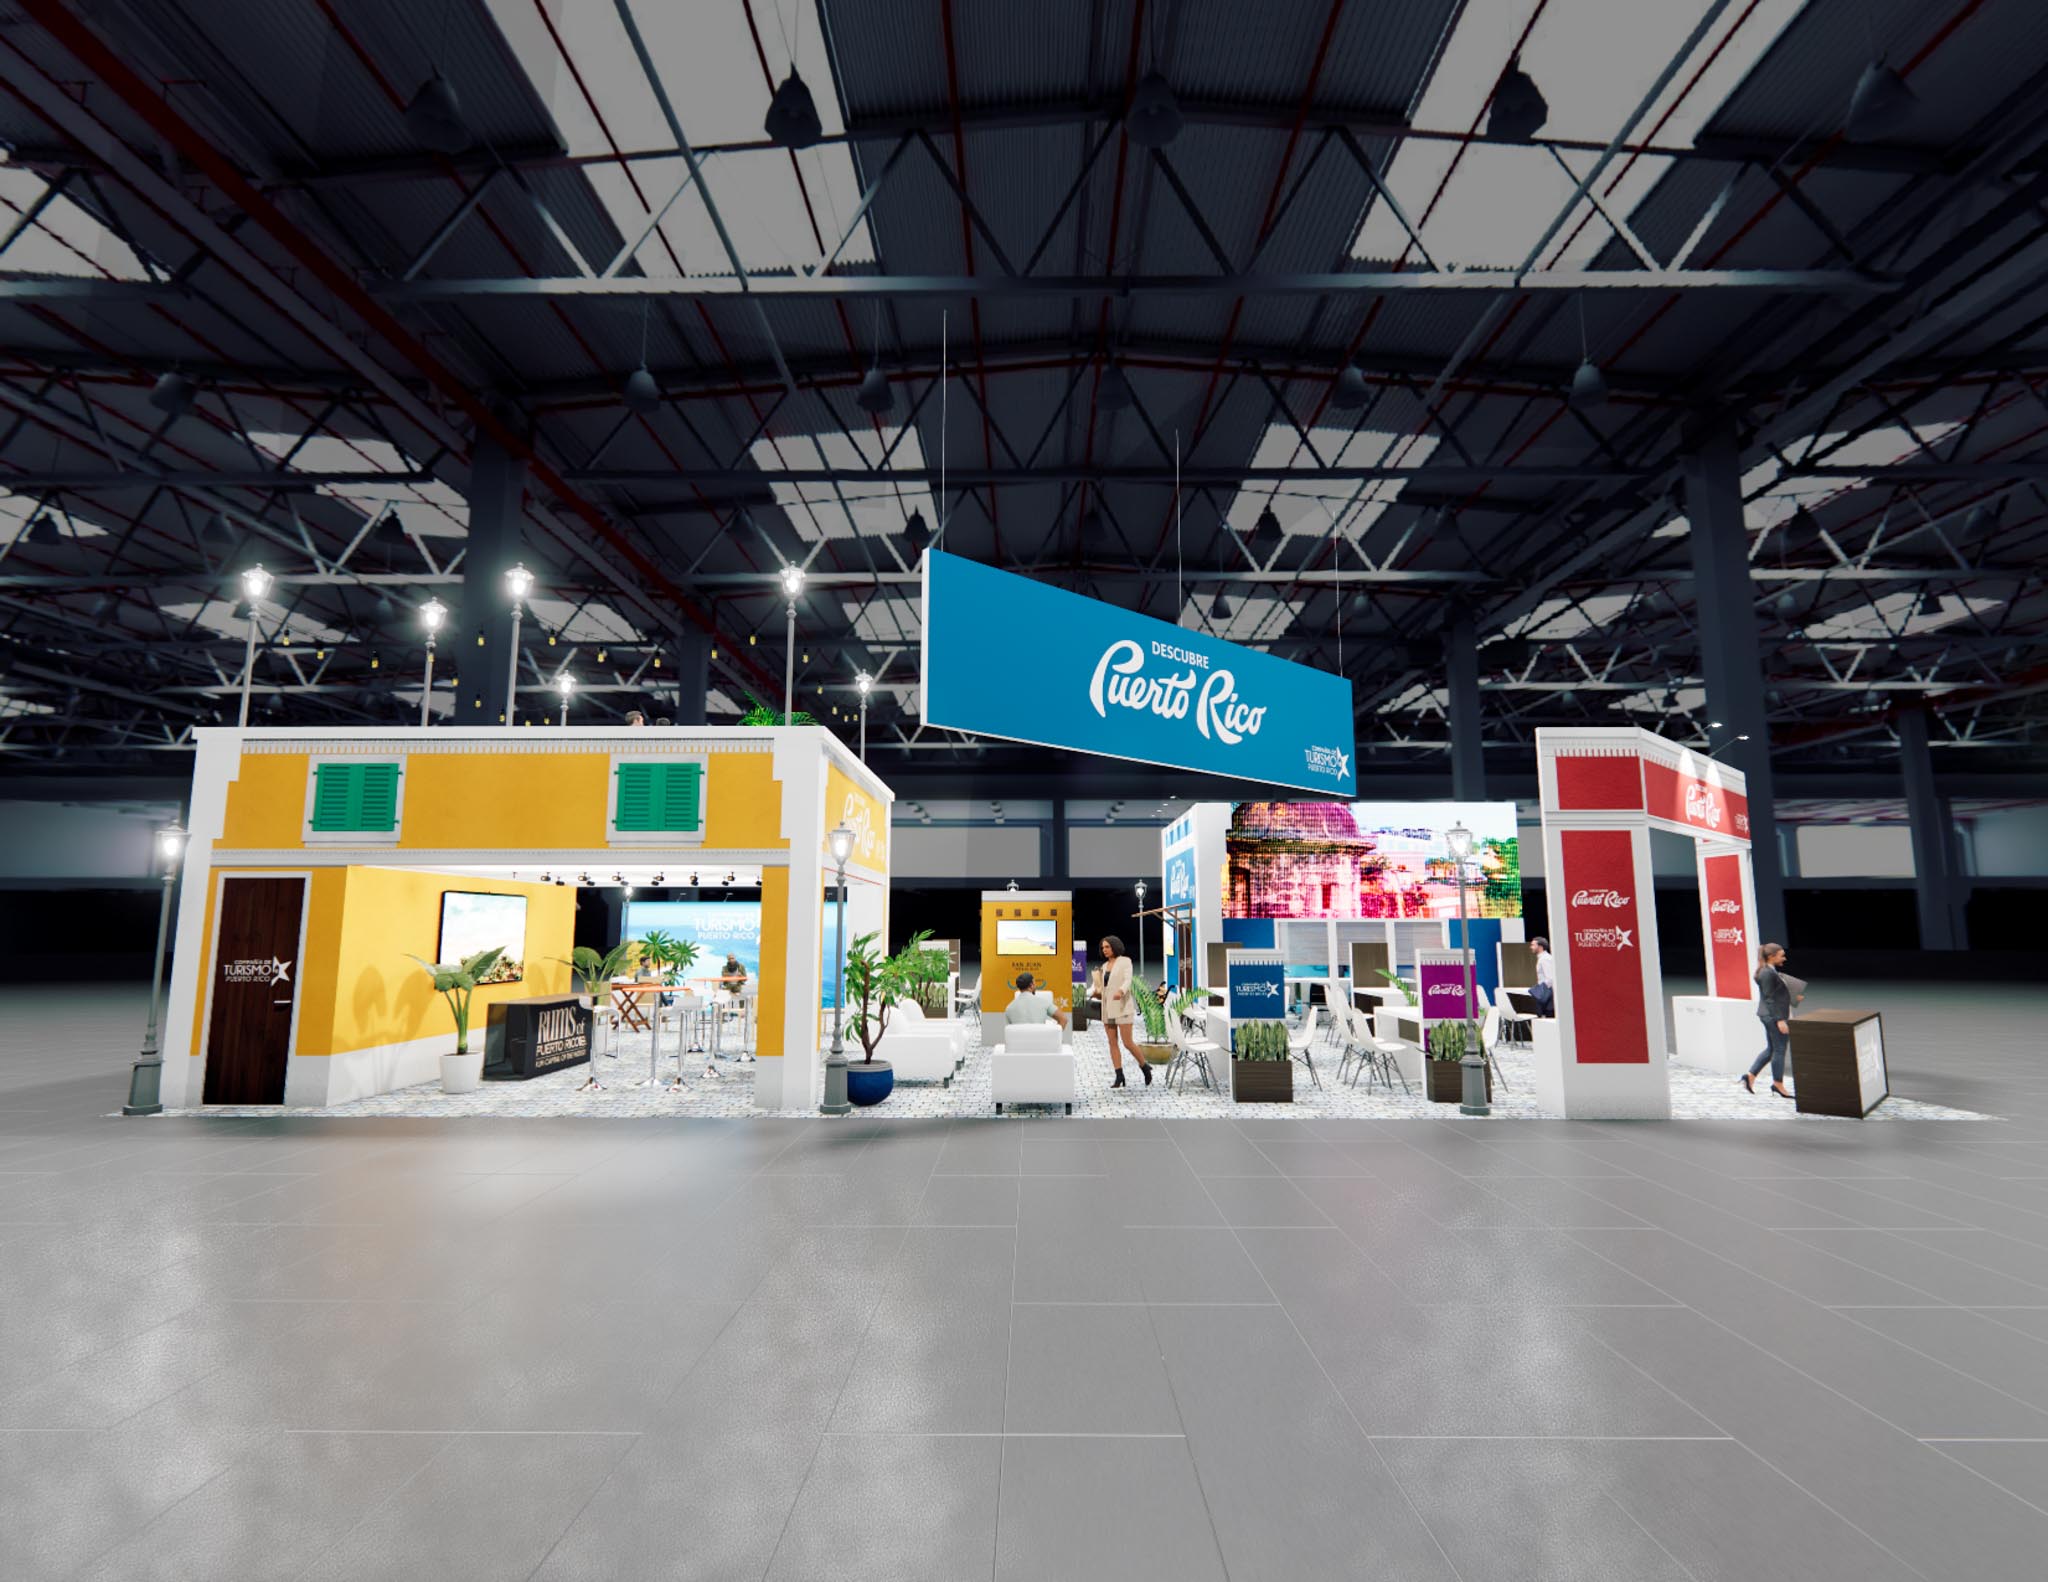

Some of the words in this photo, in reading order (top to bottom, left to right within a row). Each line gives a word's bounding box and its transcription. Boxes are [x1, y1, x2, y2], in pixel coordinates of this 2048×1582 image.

[1152, 641, 1209, 669] DESCUBRE
[1089, 640, 1197, 719] Puerto
[1196, 669, 1267, 745] Rico
[1304, 749, 1337, 768] TURISMO
[1571, 890, 1605, 908] Puerto
[1603, 890, 1631, 908] Rico
[695, 918, 755, 932] TURISMO
[1574, 932, 1616, 942] TURISMO
[224, 964, 272, 976] TURISMO
[536, 1040, 564, 1057] PUERTO
